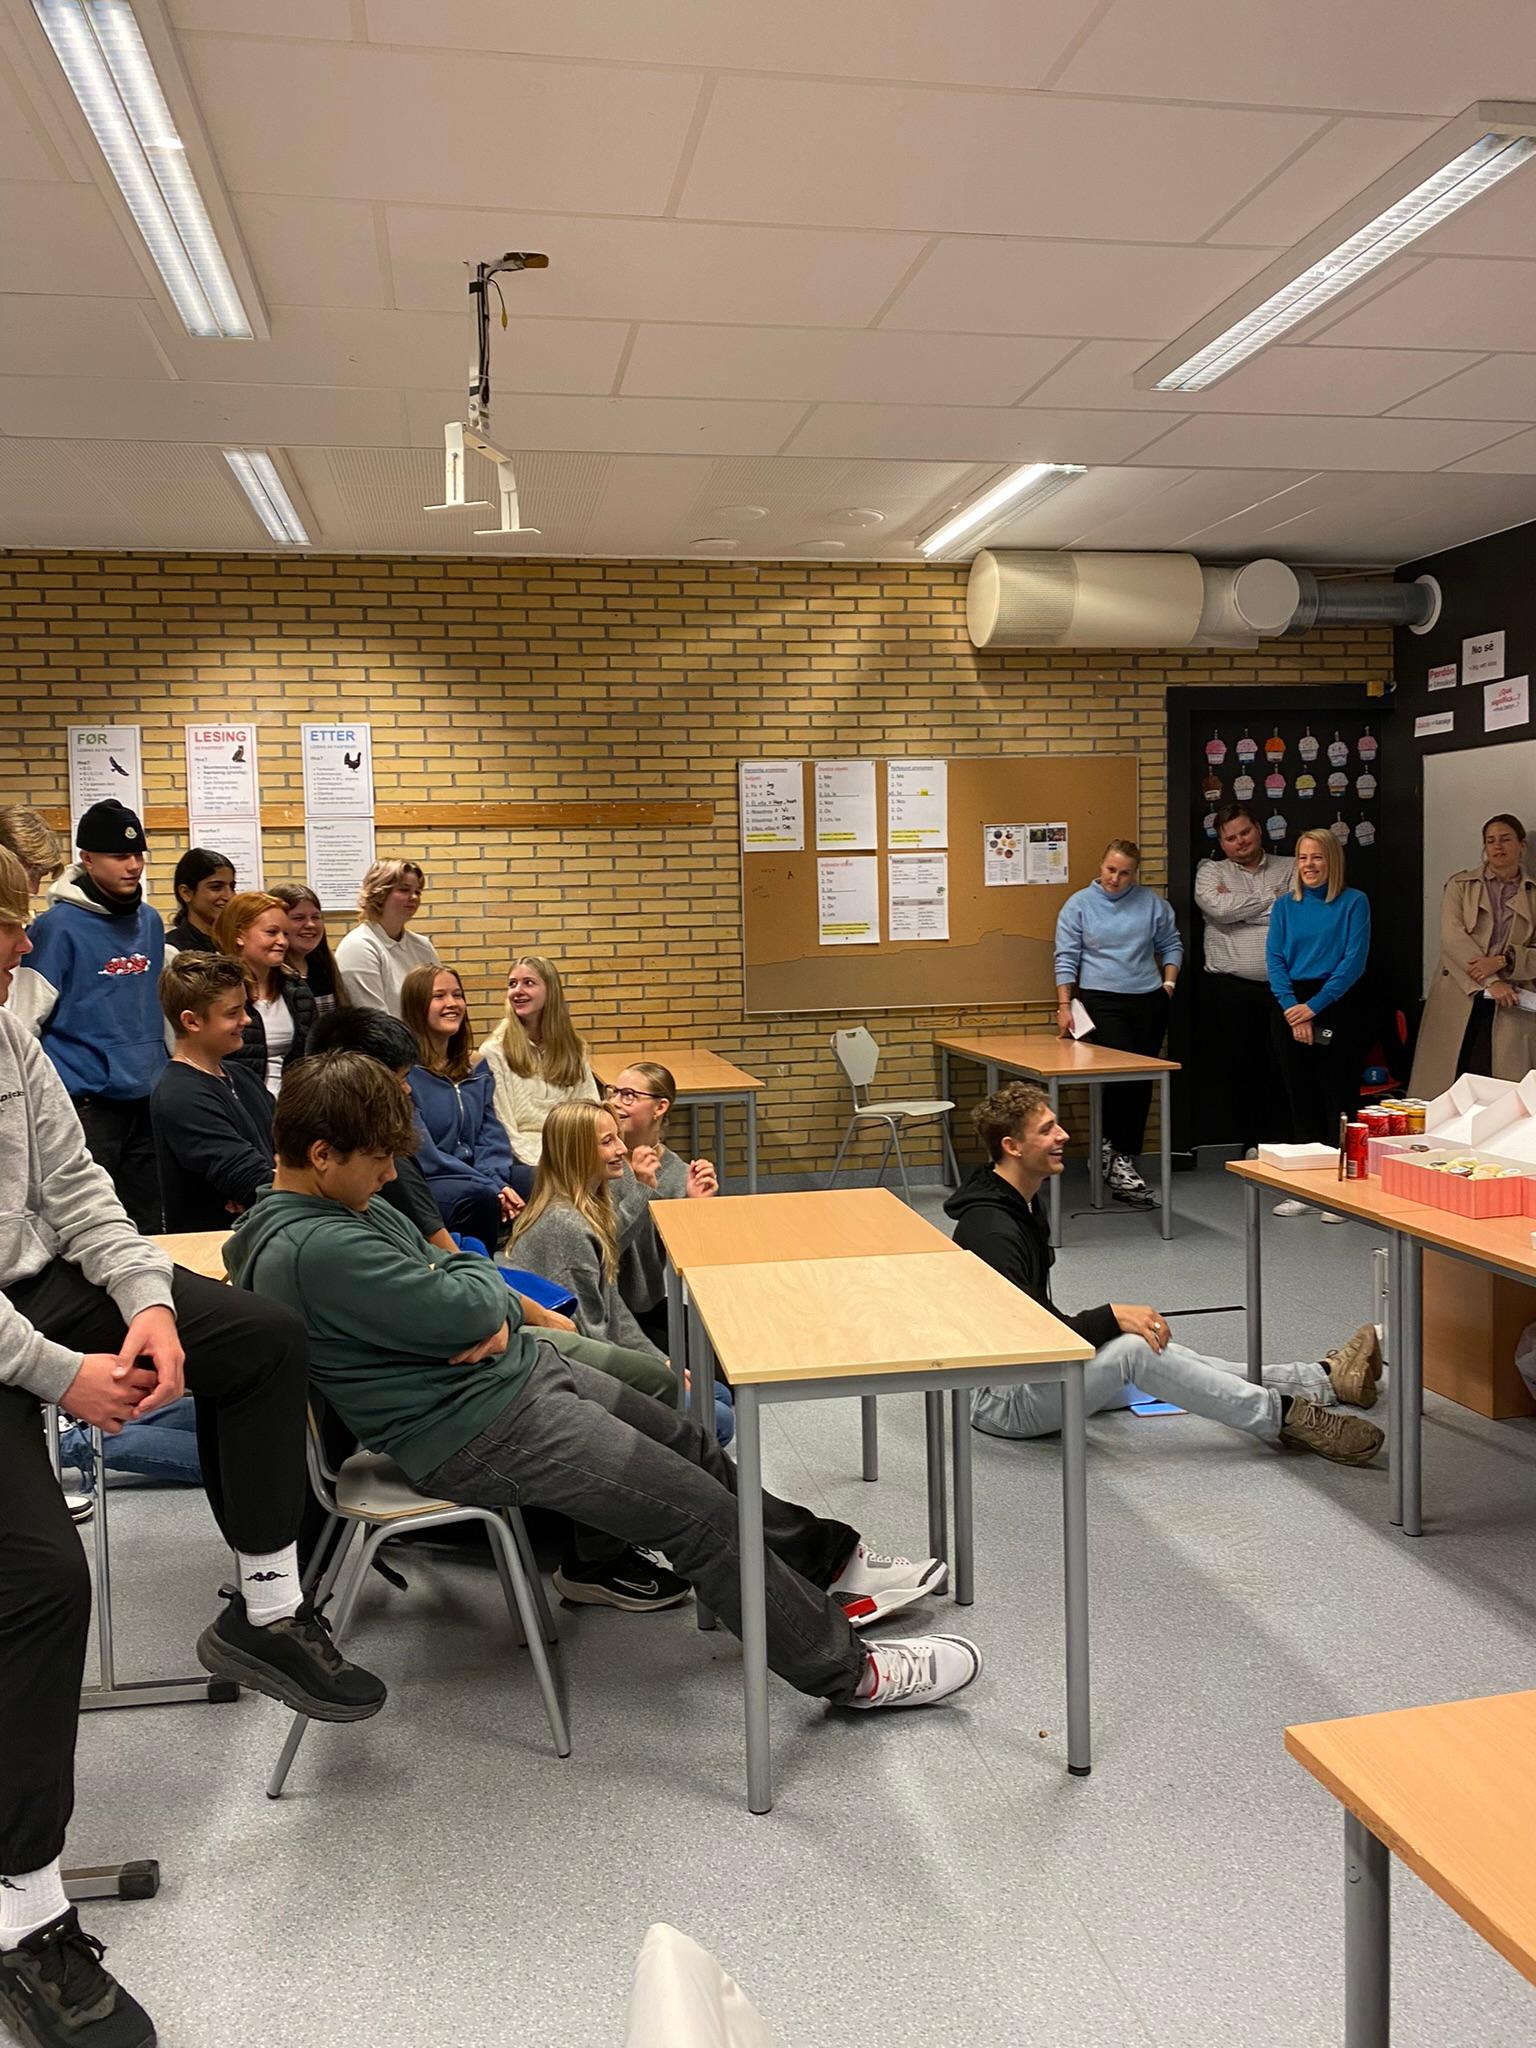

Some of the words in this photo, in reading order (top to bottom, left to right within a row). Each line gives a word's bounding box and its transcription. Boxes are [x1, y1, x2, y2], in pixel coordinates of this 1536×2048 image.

[1471, 644, 1482, 655] No
[1484, 640, 1495, 652] sé
[77, 733, 108, 745] FØR
[194, 731, 247, 743] LESING
[310, 730, 356, 742] ETTER
